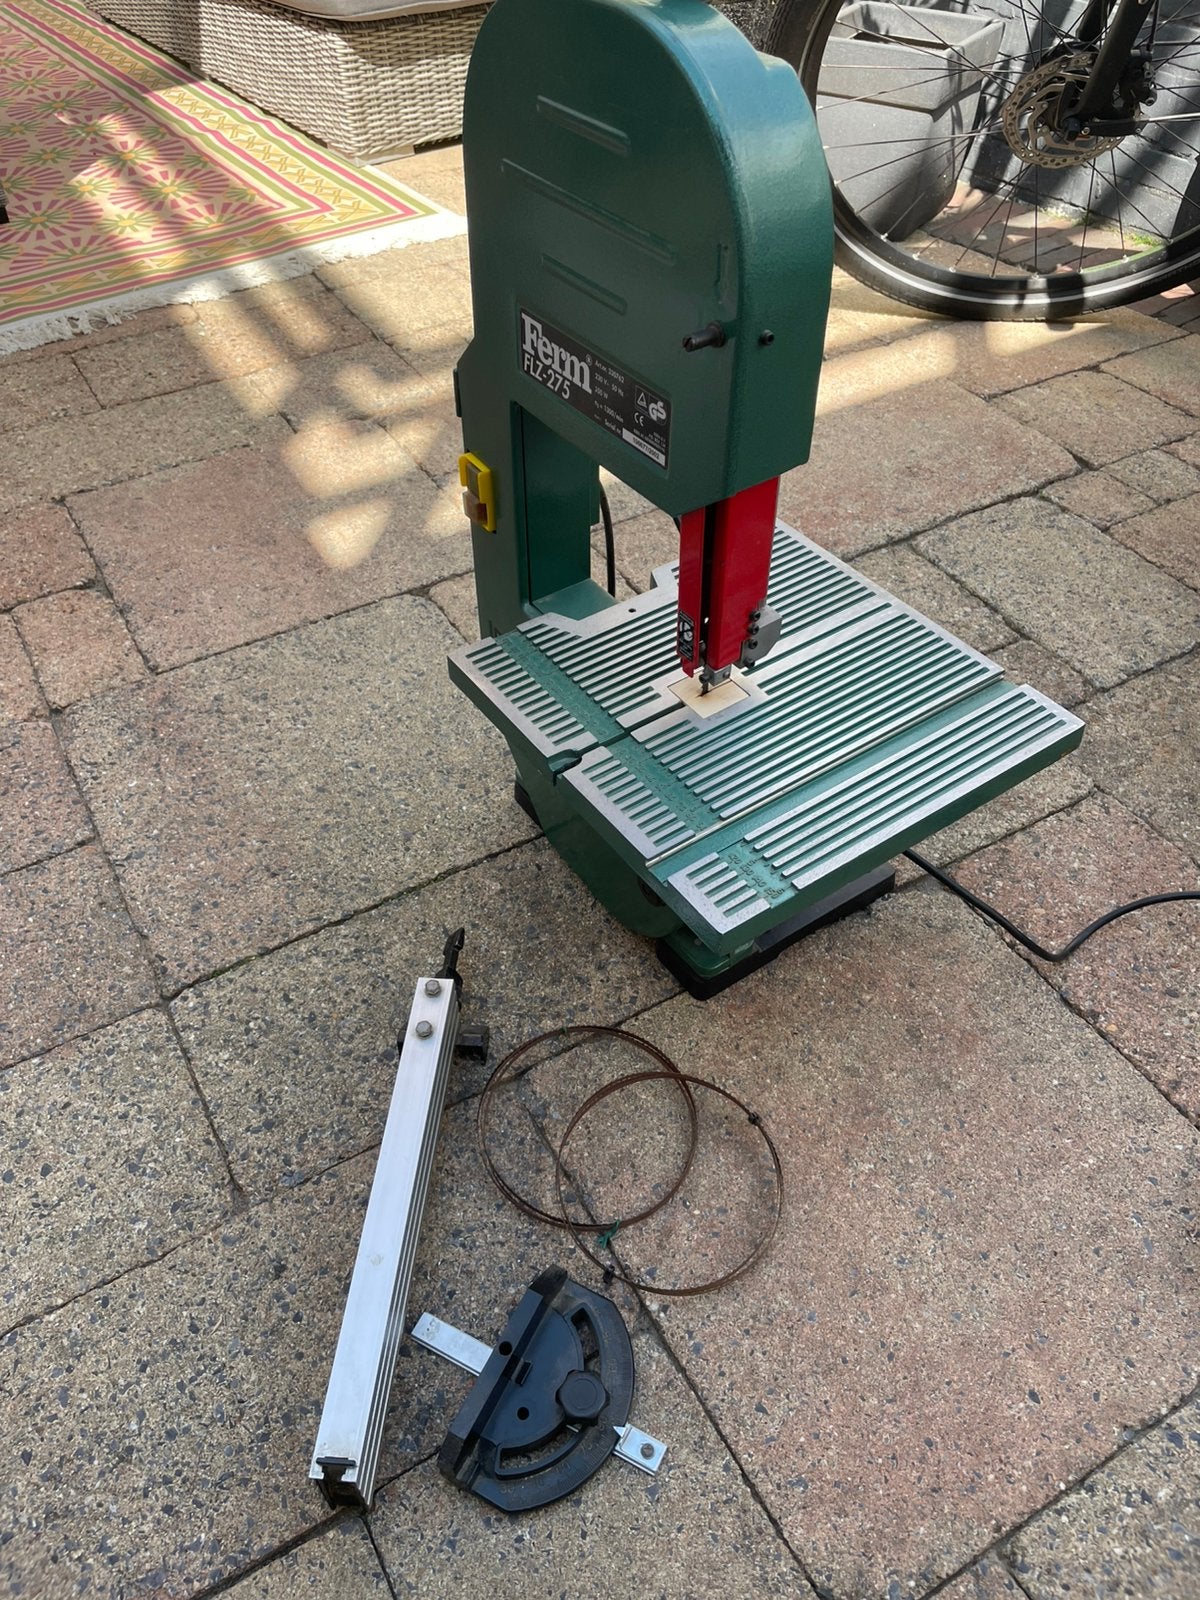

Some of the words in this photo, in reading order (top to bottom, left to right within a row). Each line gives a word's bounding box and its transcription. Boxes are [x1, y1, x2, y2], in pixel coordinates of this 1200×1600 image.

[521, 312, 592, 394] Ferm
[524, 352, 571, 400] FLZ-275
[648, 400, 667, 421] GS
